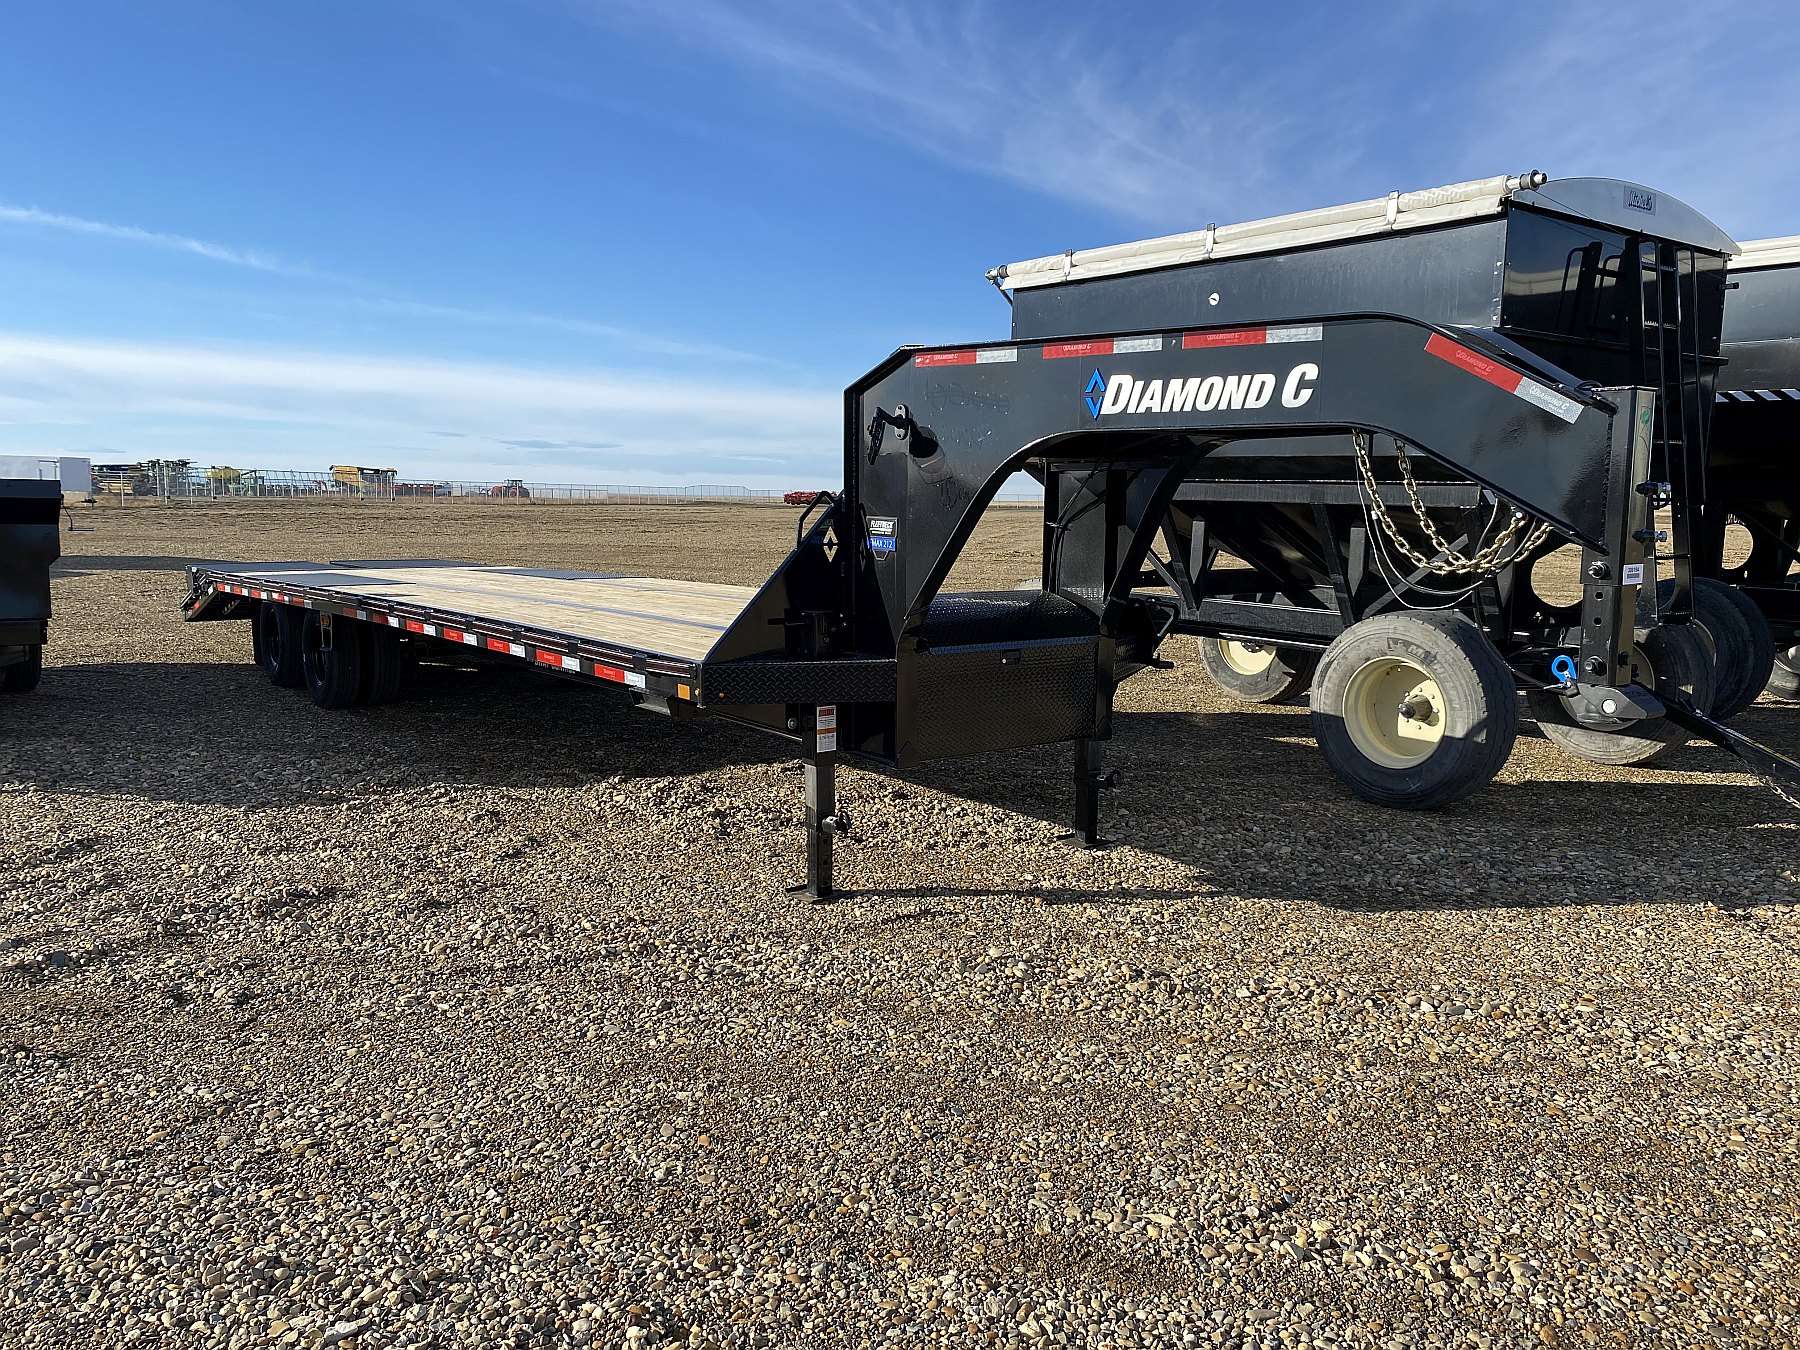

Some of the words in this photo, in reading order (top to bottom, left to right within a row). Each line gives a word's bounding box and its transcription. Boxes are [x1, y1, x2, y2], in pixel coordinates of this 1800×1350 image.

[1100, 373, 1276, 415] DIAMOND
[1281, 363, 1319, 408] C
[883, 540, 893, 548] 212
